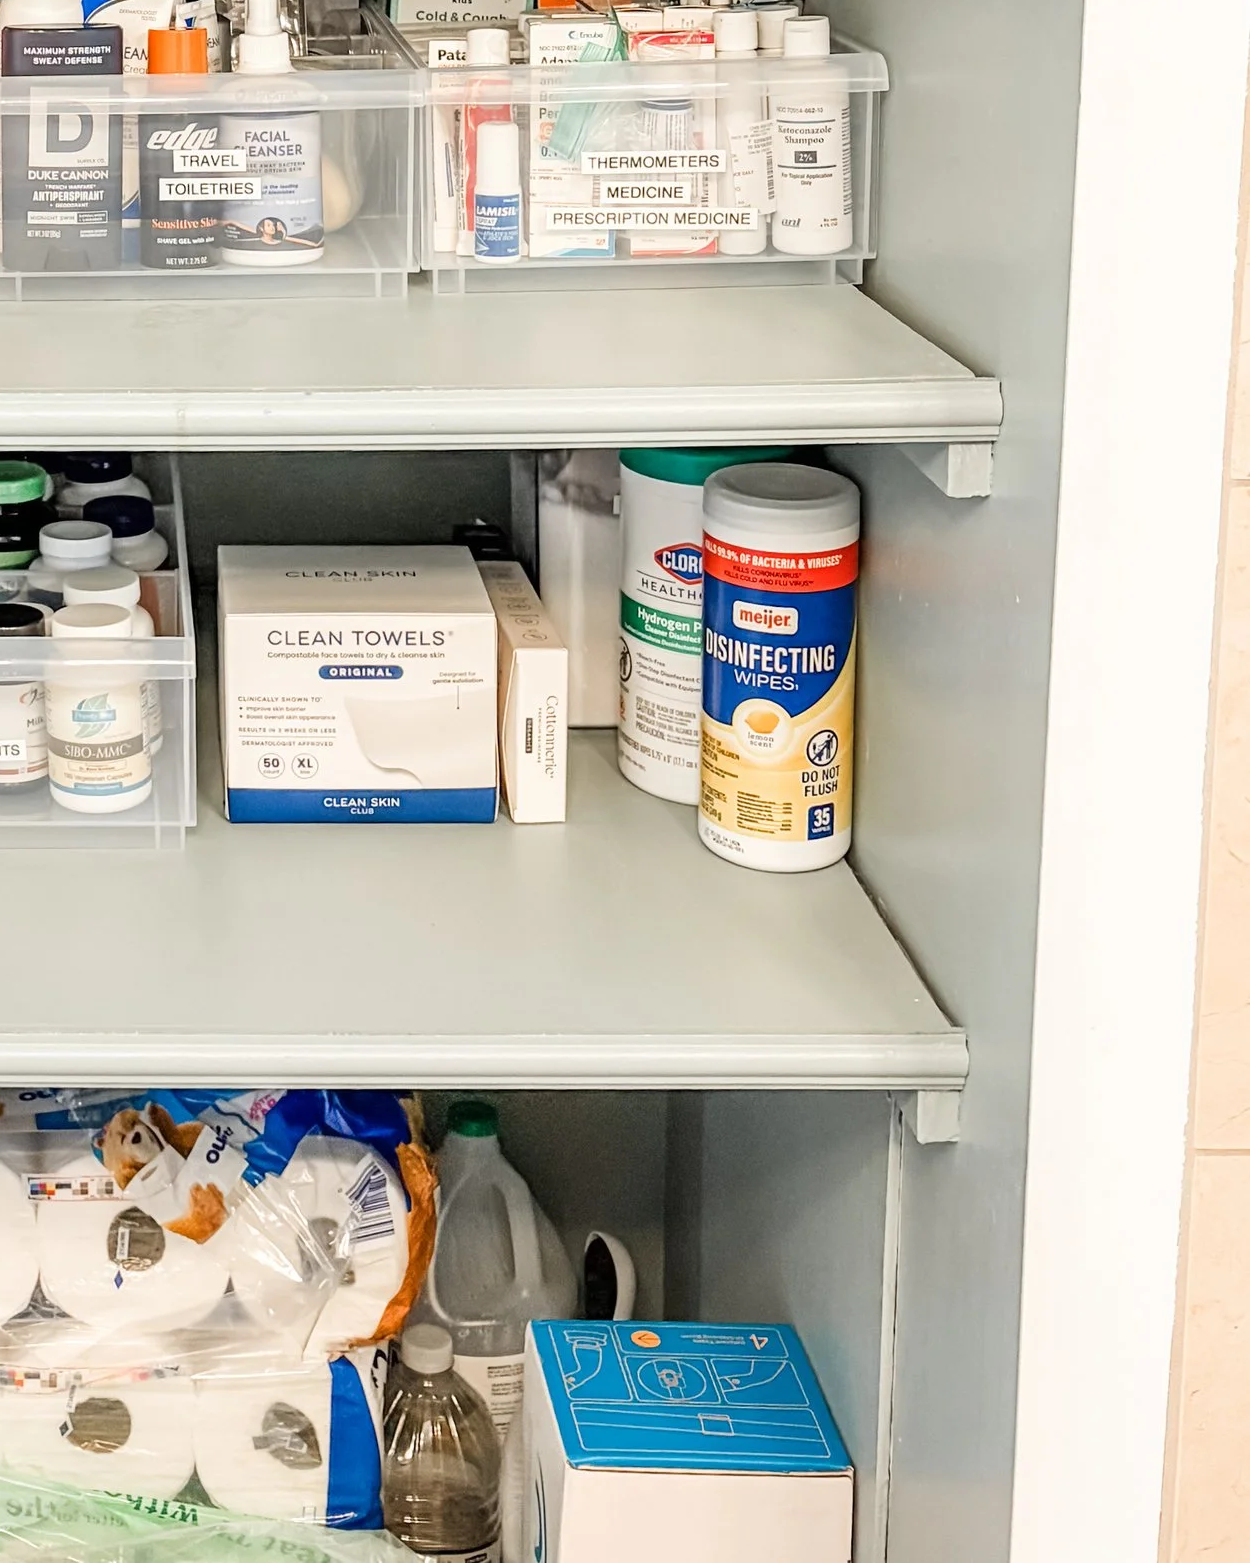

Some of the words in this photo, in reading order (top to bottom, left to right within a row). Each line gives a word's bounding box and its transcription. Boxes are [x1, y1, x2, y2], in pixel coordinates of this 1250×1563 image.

[416, 11, 447, 21] Cold
[451, 12, 458, 21] &
[463, 13, 507, 22] Cough
[24, 47, 66, 56] MAXIMUM
[68, 45, 111, 55] STRENGTH
[33, 56, 62, 66] SWEAT
[65, 55, 103, 65] DEFENSE
[778, 125, 832, 135] Ketoconazole
[146, 123, 218, 150] edge
[245, 131, 290, 143] FACIAL
[785, 136, 824, 146] Shampoo
[180, 155, 239, 167] TRAVEL
[588, 155, 719, 169] THERMOMETERS
[799, 153, 813, 162] 2%
[28, 170, 59, 180] DUKE
[61, 170, 109, 180] CANNON
[166, 183, 253, 195] TOILETRIES
[608, 186, 683, 199] MEDICINE
[33, 190, 105, 202] ANTIPERSPIRANT
[477, 206, 516, 216] LAMISIL
[152, 219, 199, 230] Sensitive
[554, 212, 669, 226] PRESCRIPTION
[675, 212, 750, 225] MEDICINE
[166, 257, 177, 265] NET
[717, 546, 738, 562] 99.9%
[740, 553, 751, 565] OF
[752, 555, 795, 569] BACTERIA
[798, 558, 805, 569] &
[285, 570, 358, 578] CLEAN
[367, 570, 417, 578] SKIN
[732, 565, 749, 575] KILLS
[723, 570, 738, 580] KILLS
[739, 574, 757, 585] COLD
[758, 577, 773, 586] AND
[775, 578, 788, 587] FLU
[638, 607, 690, 631] Hydrogen
[739, 609, 791, 628] meijer
[268, 630, 342, 645] CLEAN
[352, 630, 445, 646] TOWELS
[268, 651, 319, 659] Compostable
[376, 652, 388, 660] dry
[705, 627, 835, 675] DISINFECTING
[330, 668, 392, 677] ORIGINAL
[734, 668, 795, 692] WIPES
[748, 732, 774, 743] lemon
[750, 740, 772, 748] scent
[65, 744, 127, 759] SIBO-MMC
[263, 758, 280, 768] 50
[297, 758, 313, 768] XL
[801, 770, 819, 783] DO
[822, 766, 841, 781] NOT
[804, 782, 838, 797] FLUSH
[323, 797, 367, 807] CLEAN
[371, 797, 400, 807] SKIN
[813, 809, 830, 828] 35
